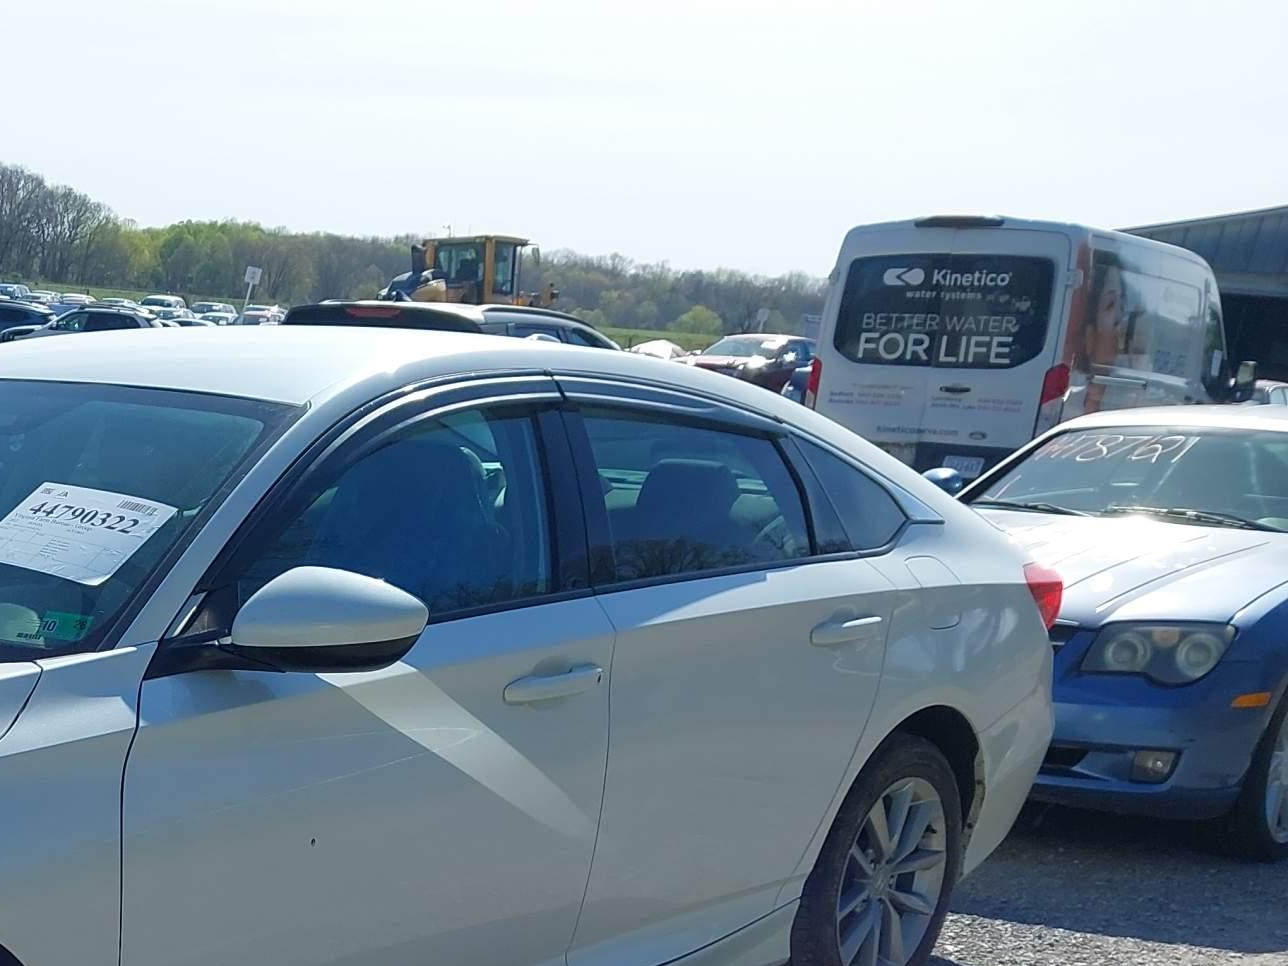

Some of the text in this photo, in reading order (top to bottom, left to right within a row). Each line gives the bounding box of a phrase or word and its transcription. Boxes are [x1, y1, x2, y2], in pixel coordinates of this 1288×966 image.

[932, 268, 1010, 287] Kinetico
[906, 290, 937, 299] water
[862, 312, 1017, 333] BETTER WATER
[857, 332, 1014, 364] FOR LIFE
[29, 501, 140, 534] 44790322
[42, 620, 56, 632] 10
